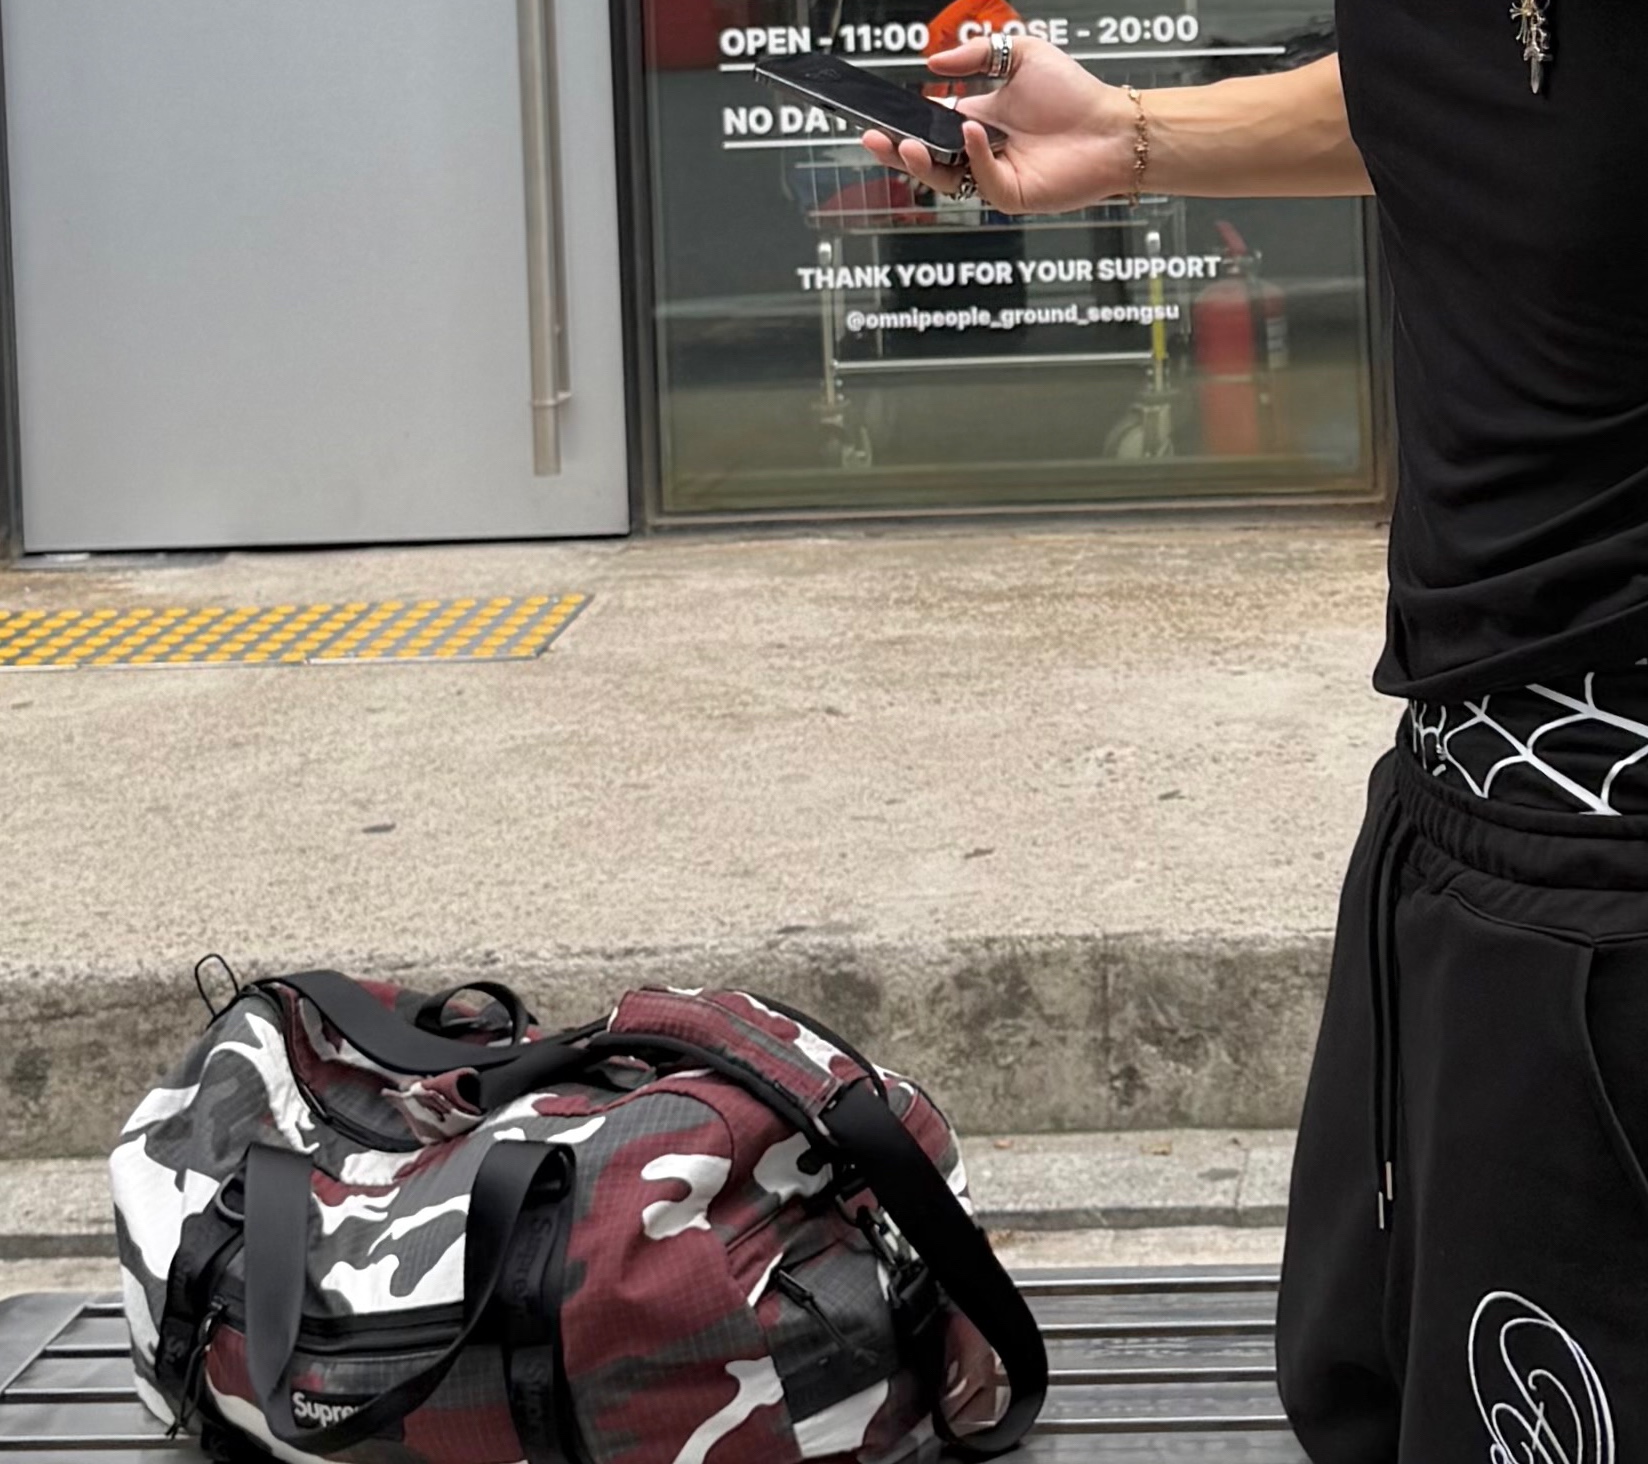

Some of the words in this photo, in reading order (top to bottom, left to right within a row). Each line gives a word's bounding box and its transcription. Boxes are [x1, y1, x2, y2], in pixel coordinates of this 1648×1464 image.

[720, 27, 812, 57] OPEN
[839, 22, 930, 54] 11:00
[1097, 14, 1199, 44] 20:00
[723, 106, 774, 135] NO
[797, 265, 893, 290] THANK
[896, 263, 955, 286] YOU
[959, 261, 1013, 286] FOR
[1017, 259, 1093, 284] YOUR
[1097, 255, 1222, 283] SUPPORT
[846, 303, 1180, 332] @omnipeople_ground_seongsu
[292, 1391, 360, 1428] Supre
